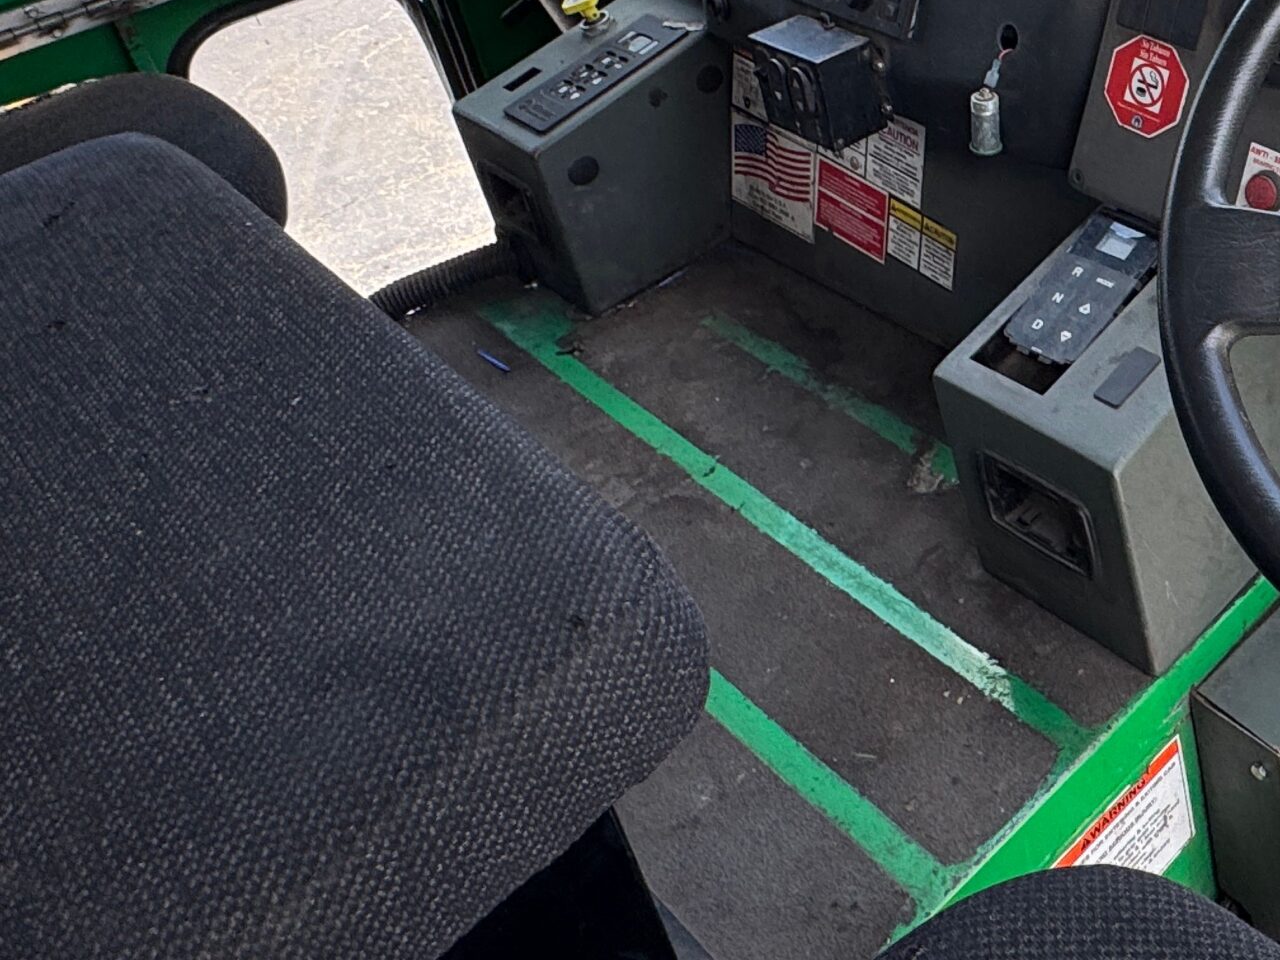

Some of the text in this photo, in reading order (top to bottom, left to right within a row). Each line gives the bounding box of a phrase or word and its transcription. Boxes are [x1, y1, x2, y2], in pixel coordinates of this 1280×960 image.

[1072, 266, 1084, 278] R
[1051, 292, 1065, 304] N
[1031, 318, 1044, 330] D
[1089, 778, 1146, 840] WARNING
